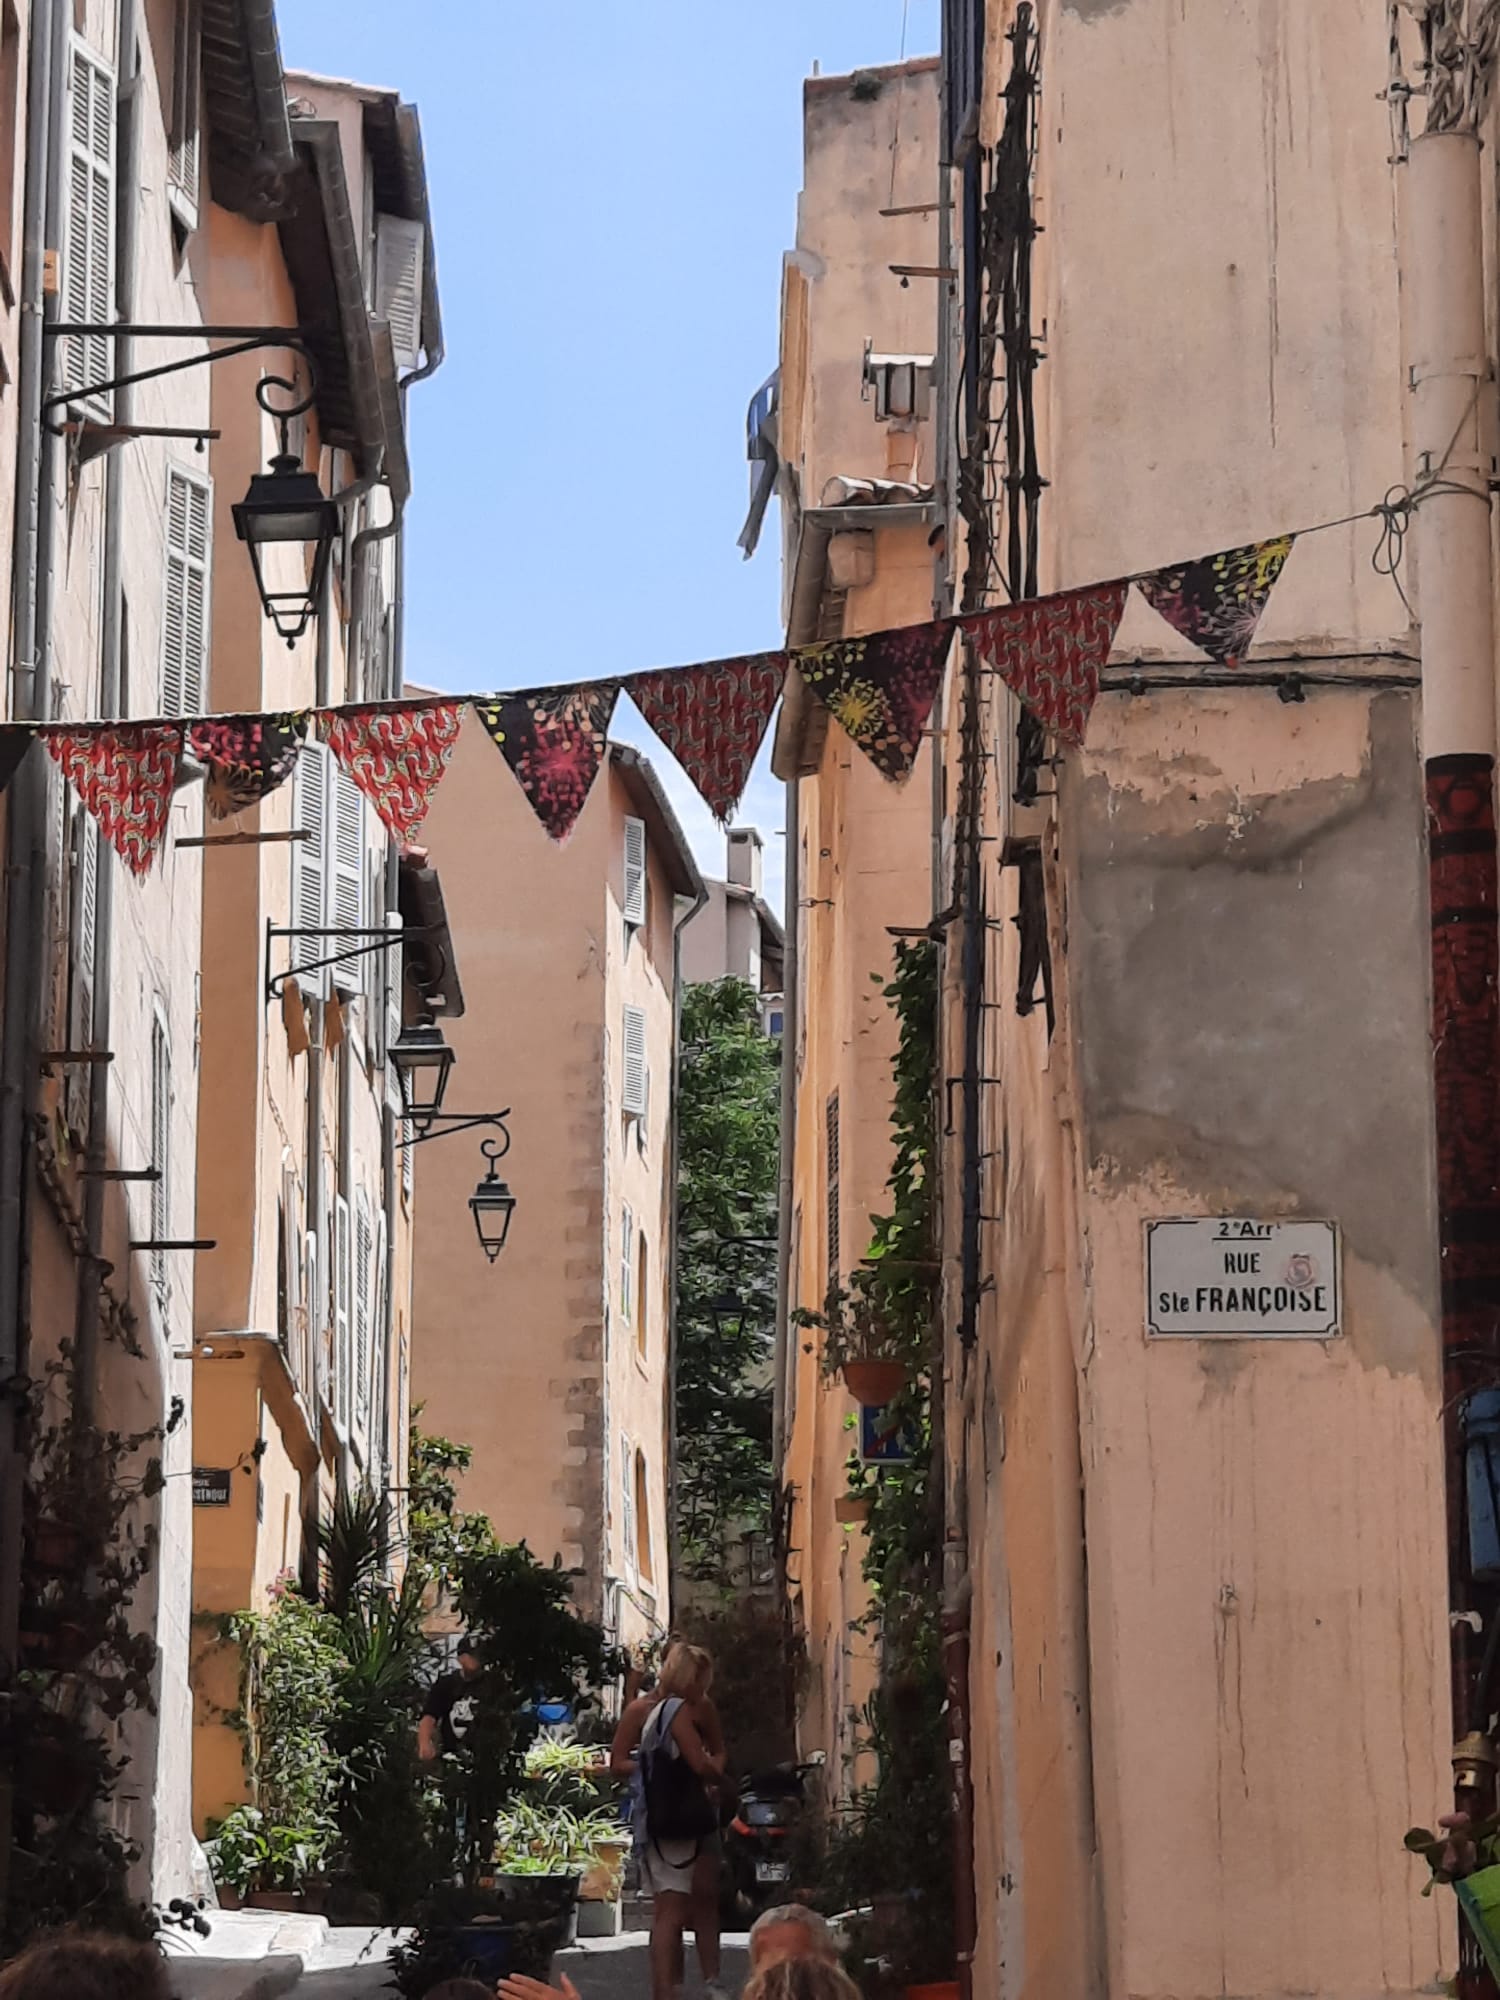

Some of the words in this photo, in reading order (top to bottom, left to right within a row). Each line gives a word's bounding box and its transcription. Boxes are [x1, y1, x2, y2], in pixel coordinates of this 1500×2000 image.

[1224, 1252, 1261, 1274] RUE
[1159, 1292, 1190, 1313] Ste
[1195, 1286, 1327, 1317] FRANÇOISE
